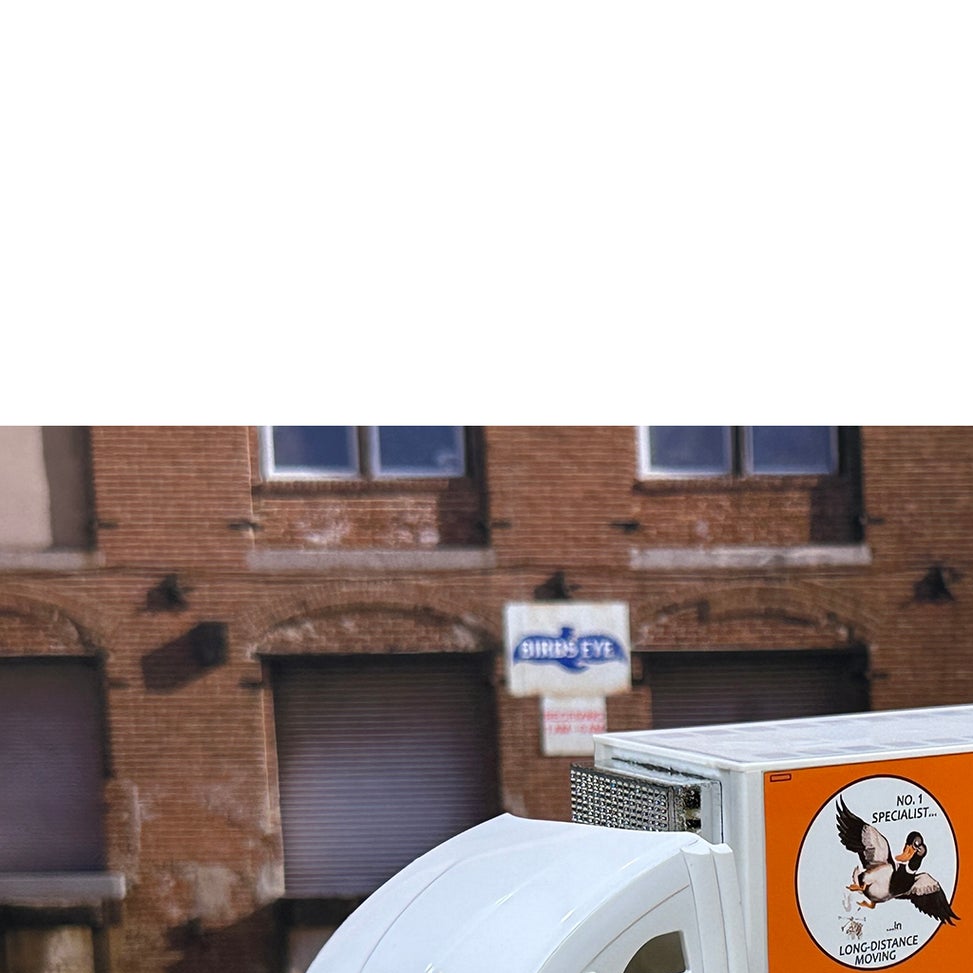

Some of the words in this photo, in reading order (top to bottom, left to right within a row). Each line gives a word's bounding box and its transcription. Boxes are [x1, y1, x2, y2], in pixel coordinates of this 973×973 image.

[580, 640, 615, 659] EYE
[896, 794, 916, 806] NO.
[918, 793, 923, 804] 1
[871, 807, 937, 823] SPECIALIST...
[839, 935, 919, 956] LONG-DISTANCE
[854, 950, 897, 966] MOVING
